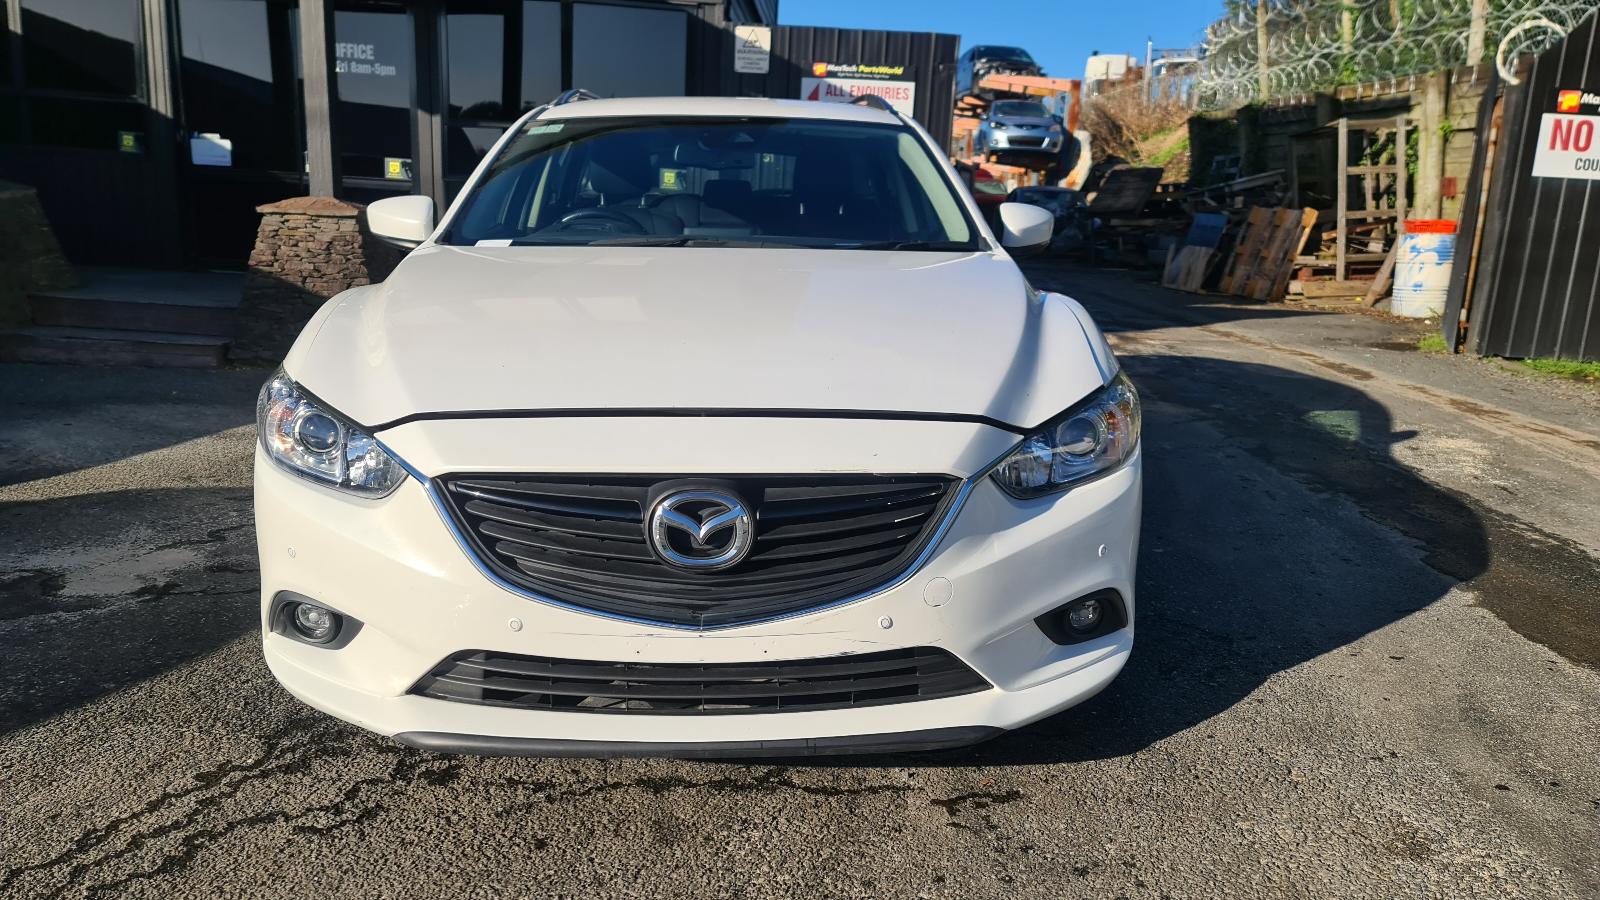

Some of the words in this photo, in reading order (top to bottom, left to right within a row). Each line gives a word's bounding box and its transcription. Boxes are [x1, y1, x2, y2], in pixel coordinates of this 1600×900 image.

[350, 61, 396, 76] 8am-5pm
[825, 83, 846, 97] ALL
[849, 85, 910, 101] ENQUIRIES
[1549, 118, 1594, 153] NO
[1575, 158, 1600, 172] COU
